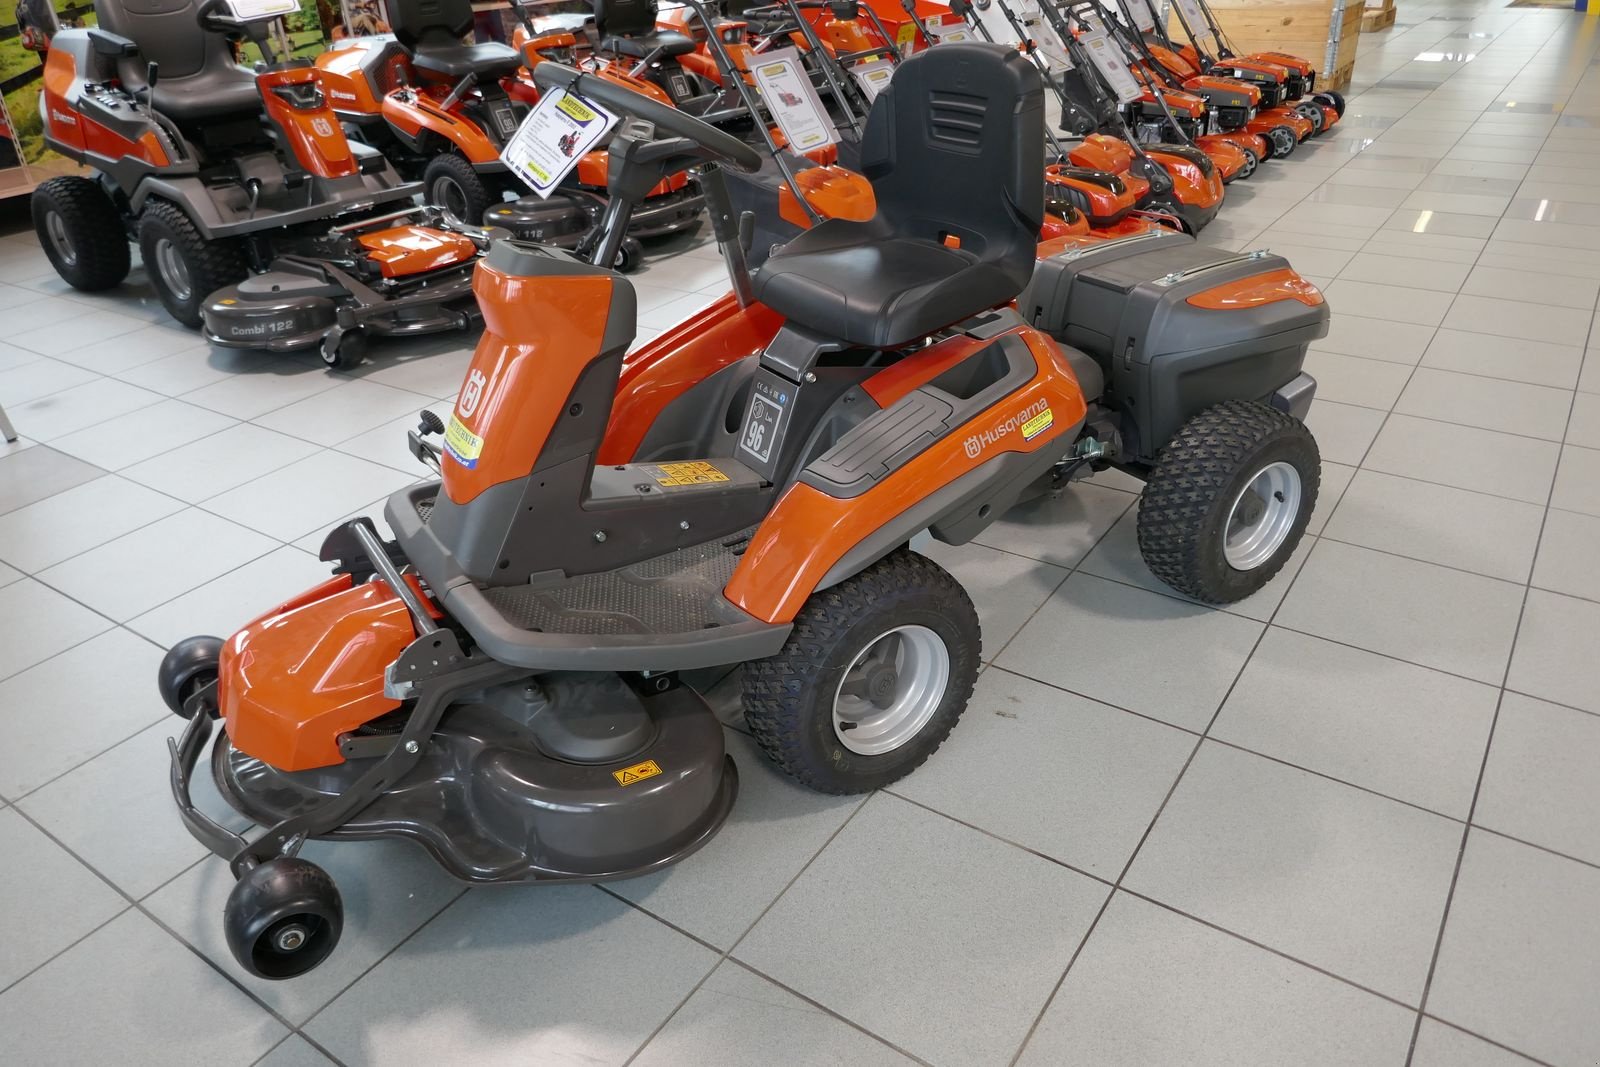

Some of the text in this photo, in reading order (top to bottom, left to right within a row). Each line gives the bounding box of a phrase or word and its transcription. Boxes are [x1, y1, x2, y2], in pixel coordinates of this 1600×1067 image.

[524, 229, 544, 238] 112
[231, 320, 293, 336] Combi 122
[979, 397, 1049, 449] Husqvarna
[747, 421, 765, 451] 96
